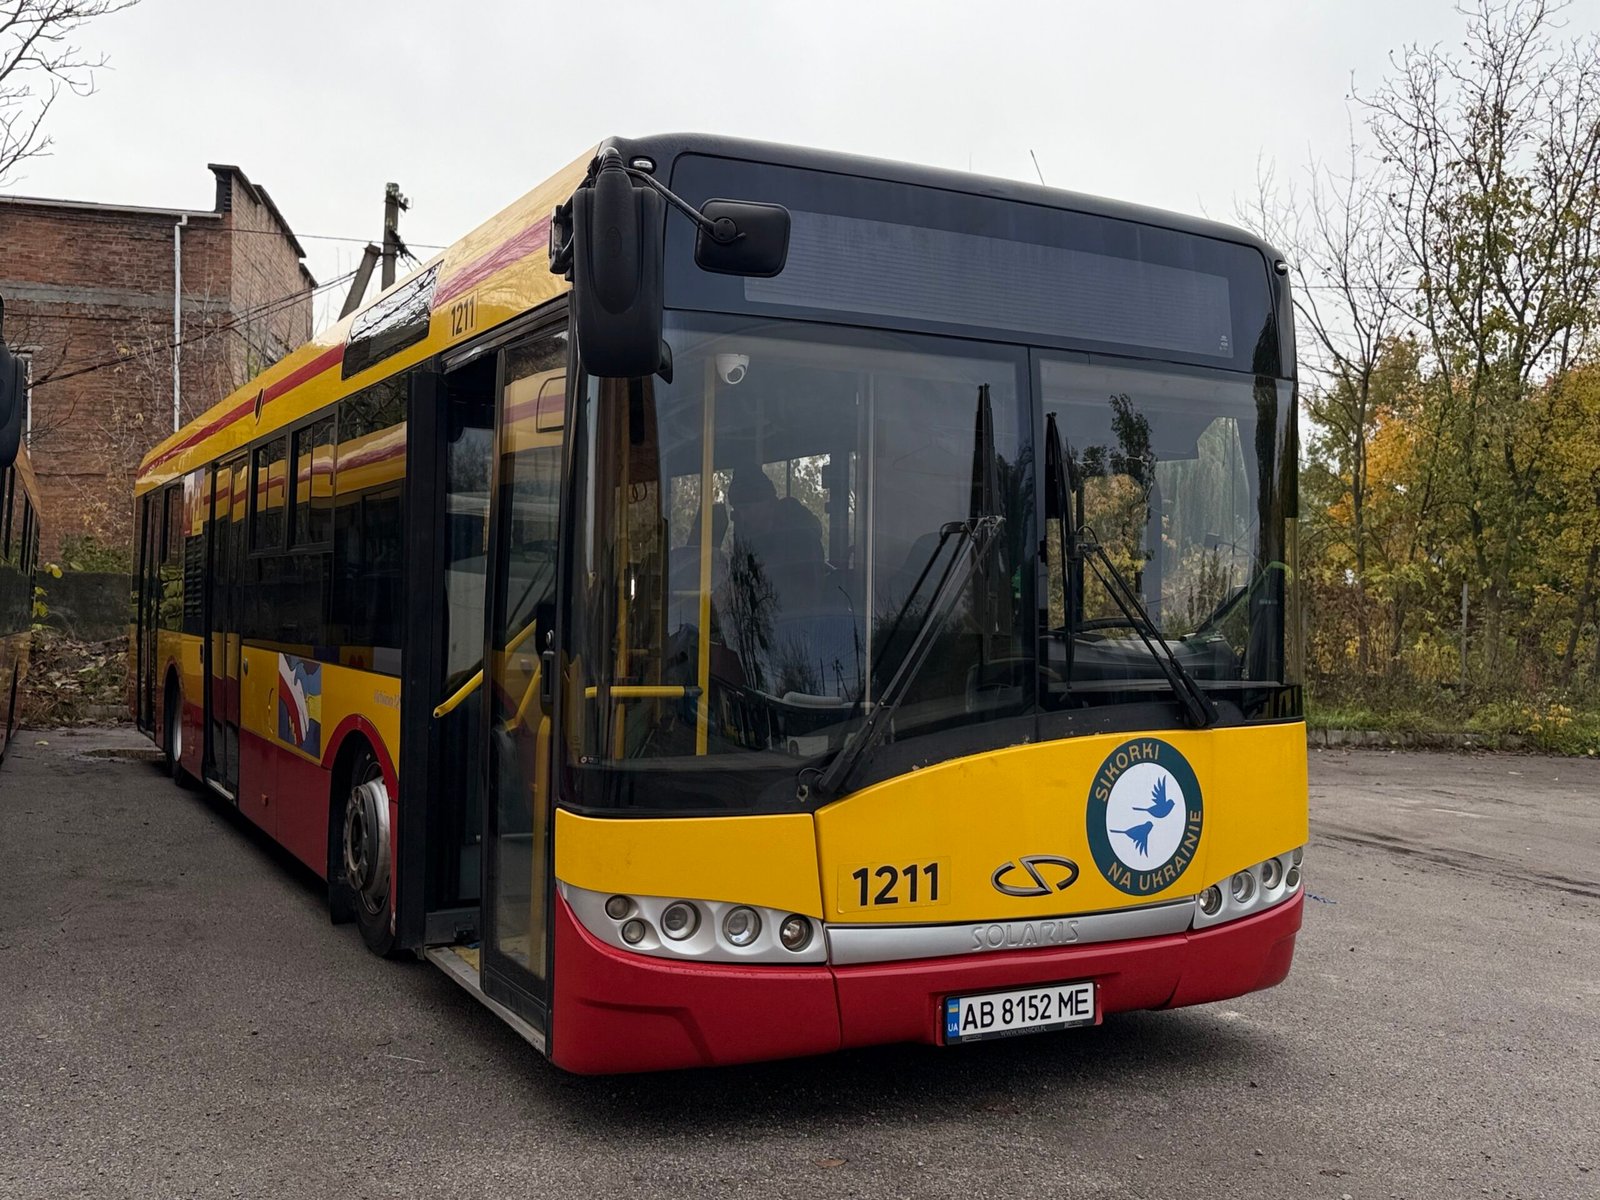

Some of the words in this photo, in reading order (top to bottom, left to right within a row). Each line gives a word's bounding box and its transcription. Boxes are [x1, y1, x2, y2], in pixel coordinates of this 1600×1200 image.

[451, 295, 474, 336] 1211
[1095, 742, 1160, 802] SIKORKI
[1107, 861, 1131, 889] NA
[1139, 810, 1202, 891] UKRAINIE
[852, 862, 938, 906] 1211
[971, 920, 1079, 951] SOLARIS
[947, 1022, 959, 1032] UA
[962, 1000, 995, 1031] AB
[1001, 993, 1052, 1025] 8152
[1057, 988, 1090, 1018] ME
